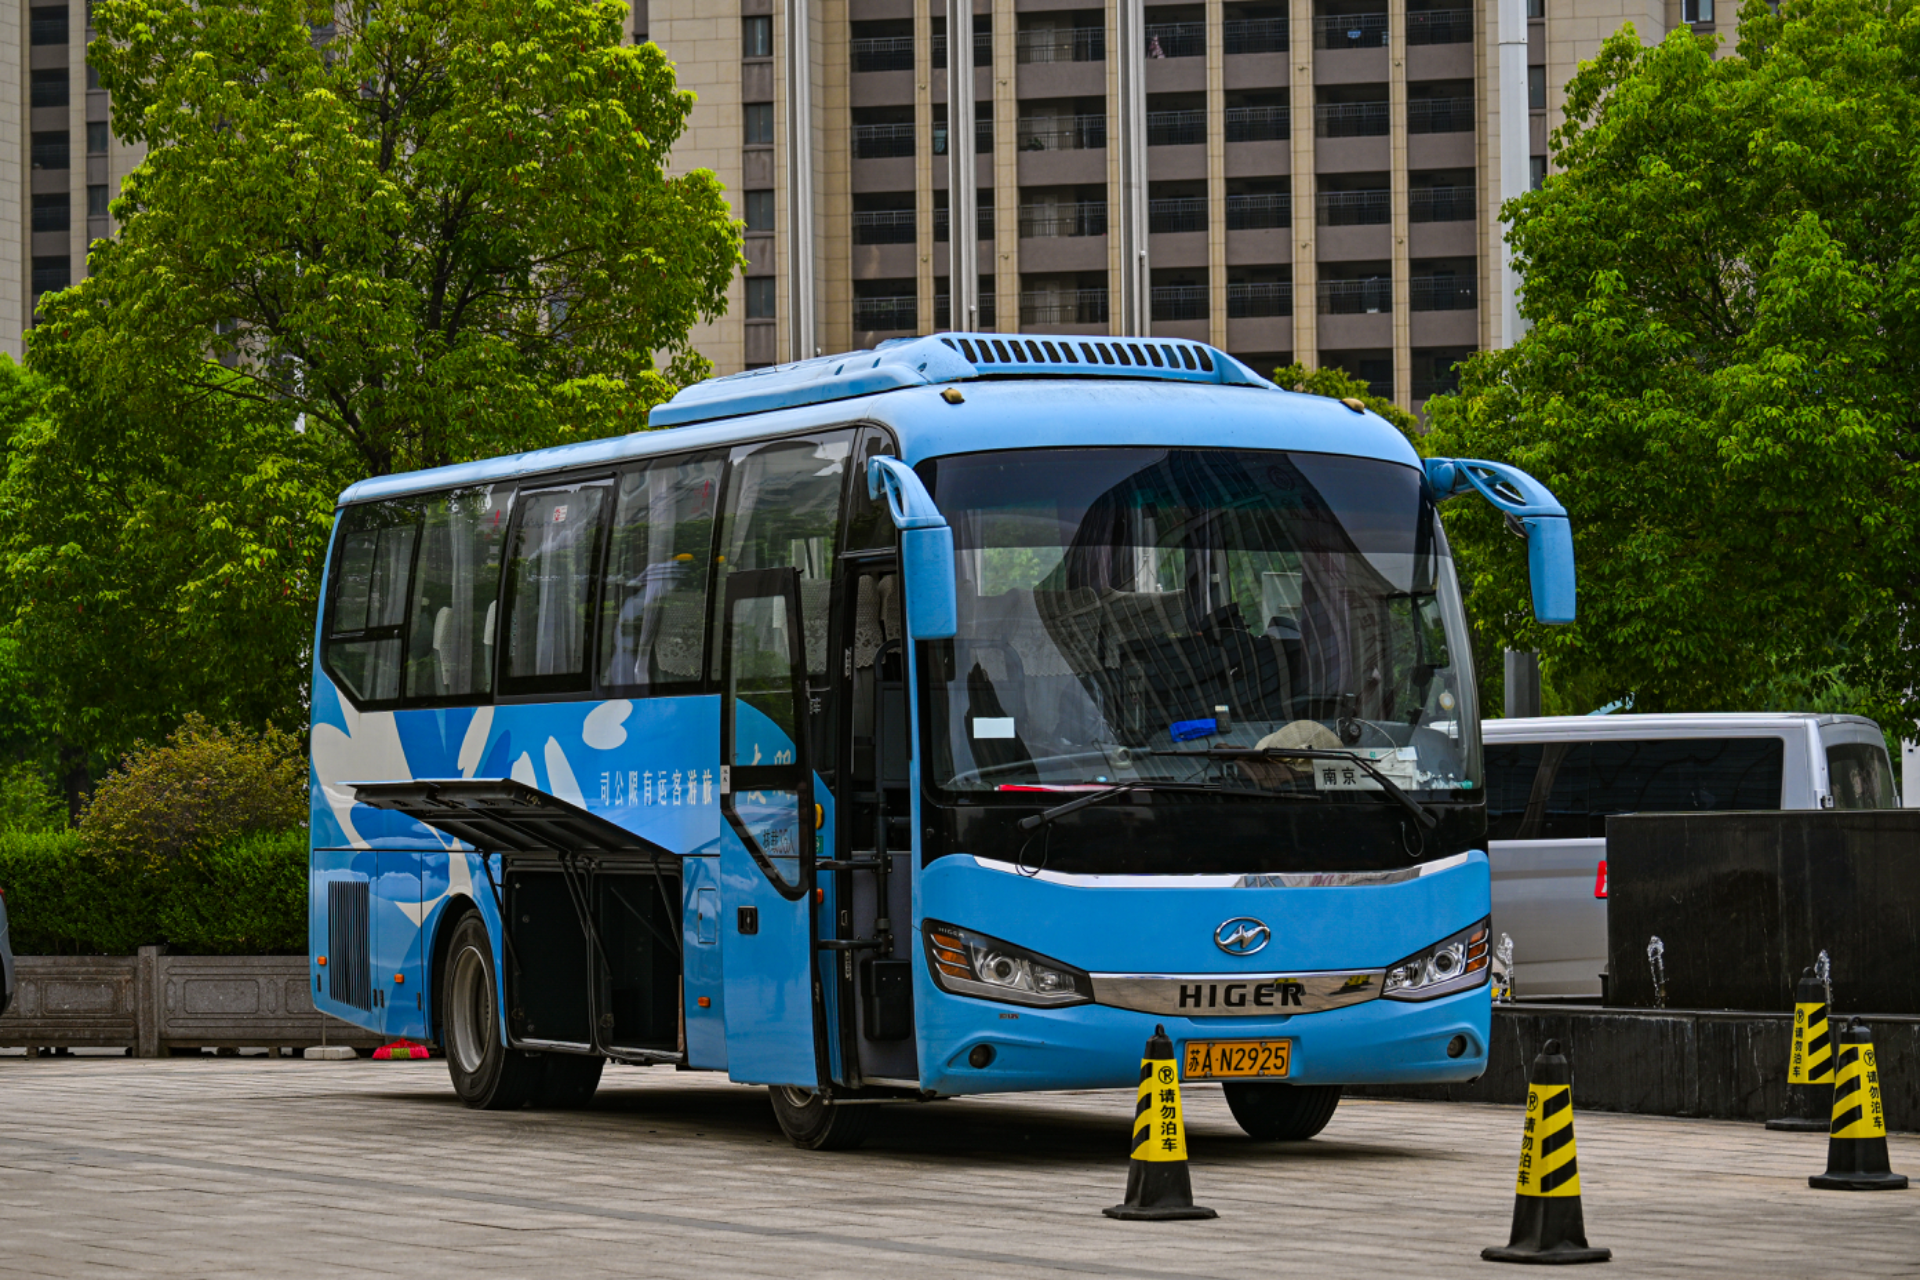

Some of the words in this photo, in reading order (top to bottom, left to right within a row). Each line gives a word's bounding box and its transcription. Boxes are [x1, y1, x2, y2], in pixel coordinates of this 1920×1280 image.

[1178, 983, 1303, 1008] HIGER
[1159, 1088, 1177, 1151] 请勿泊车
[1866, 1072, 1882, 1128] 请勿泊车
[1518, 1117, 1535, 1186] 请勿泊车
